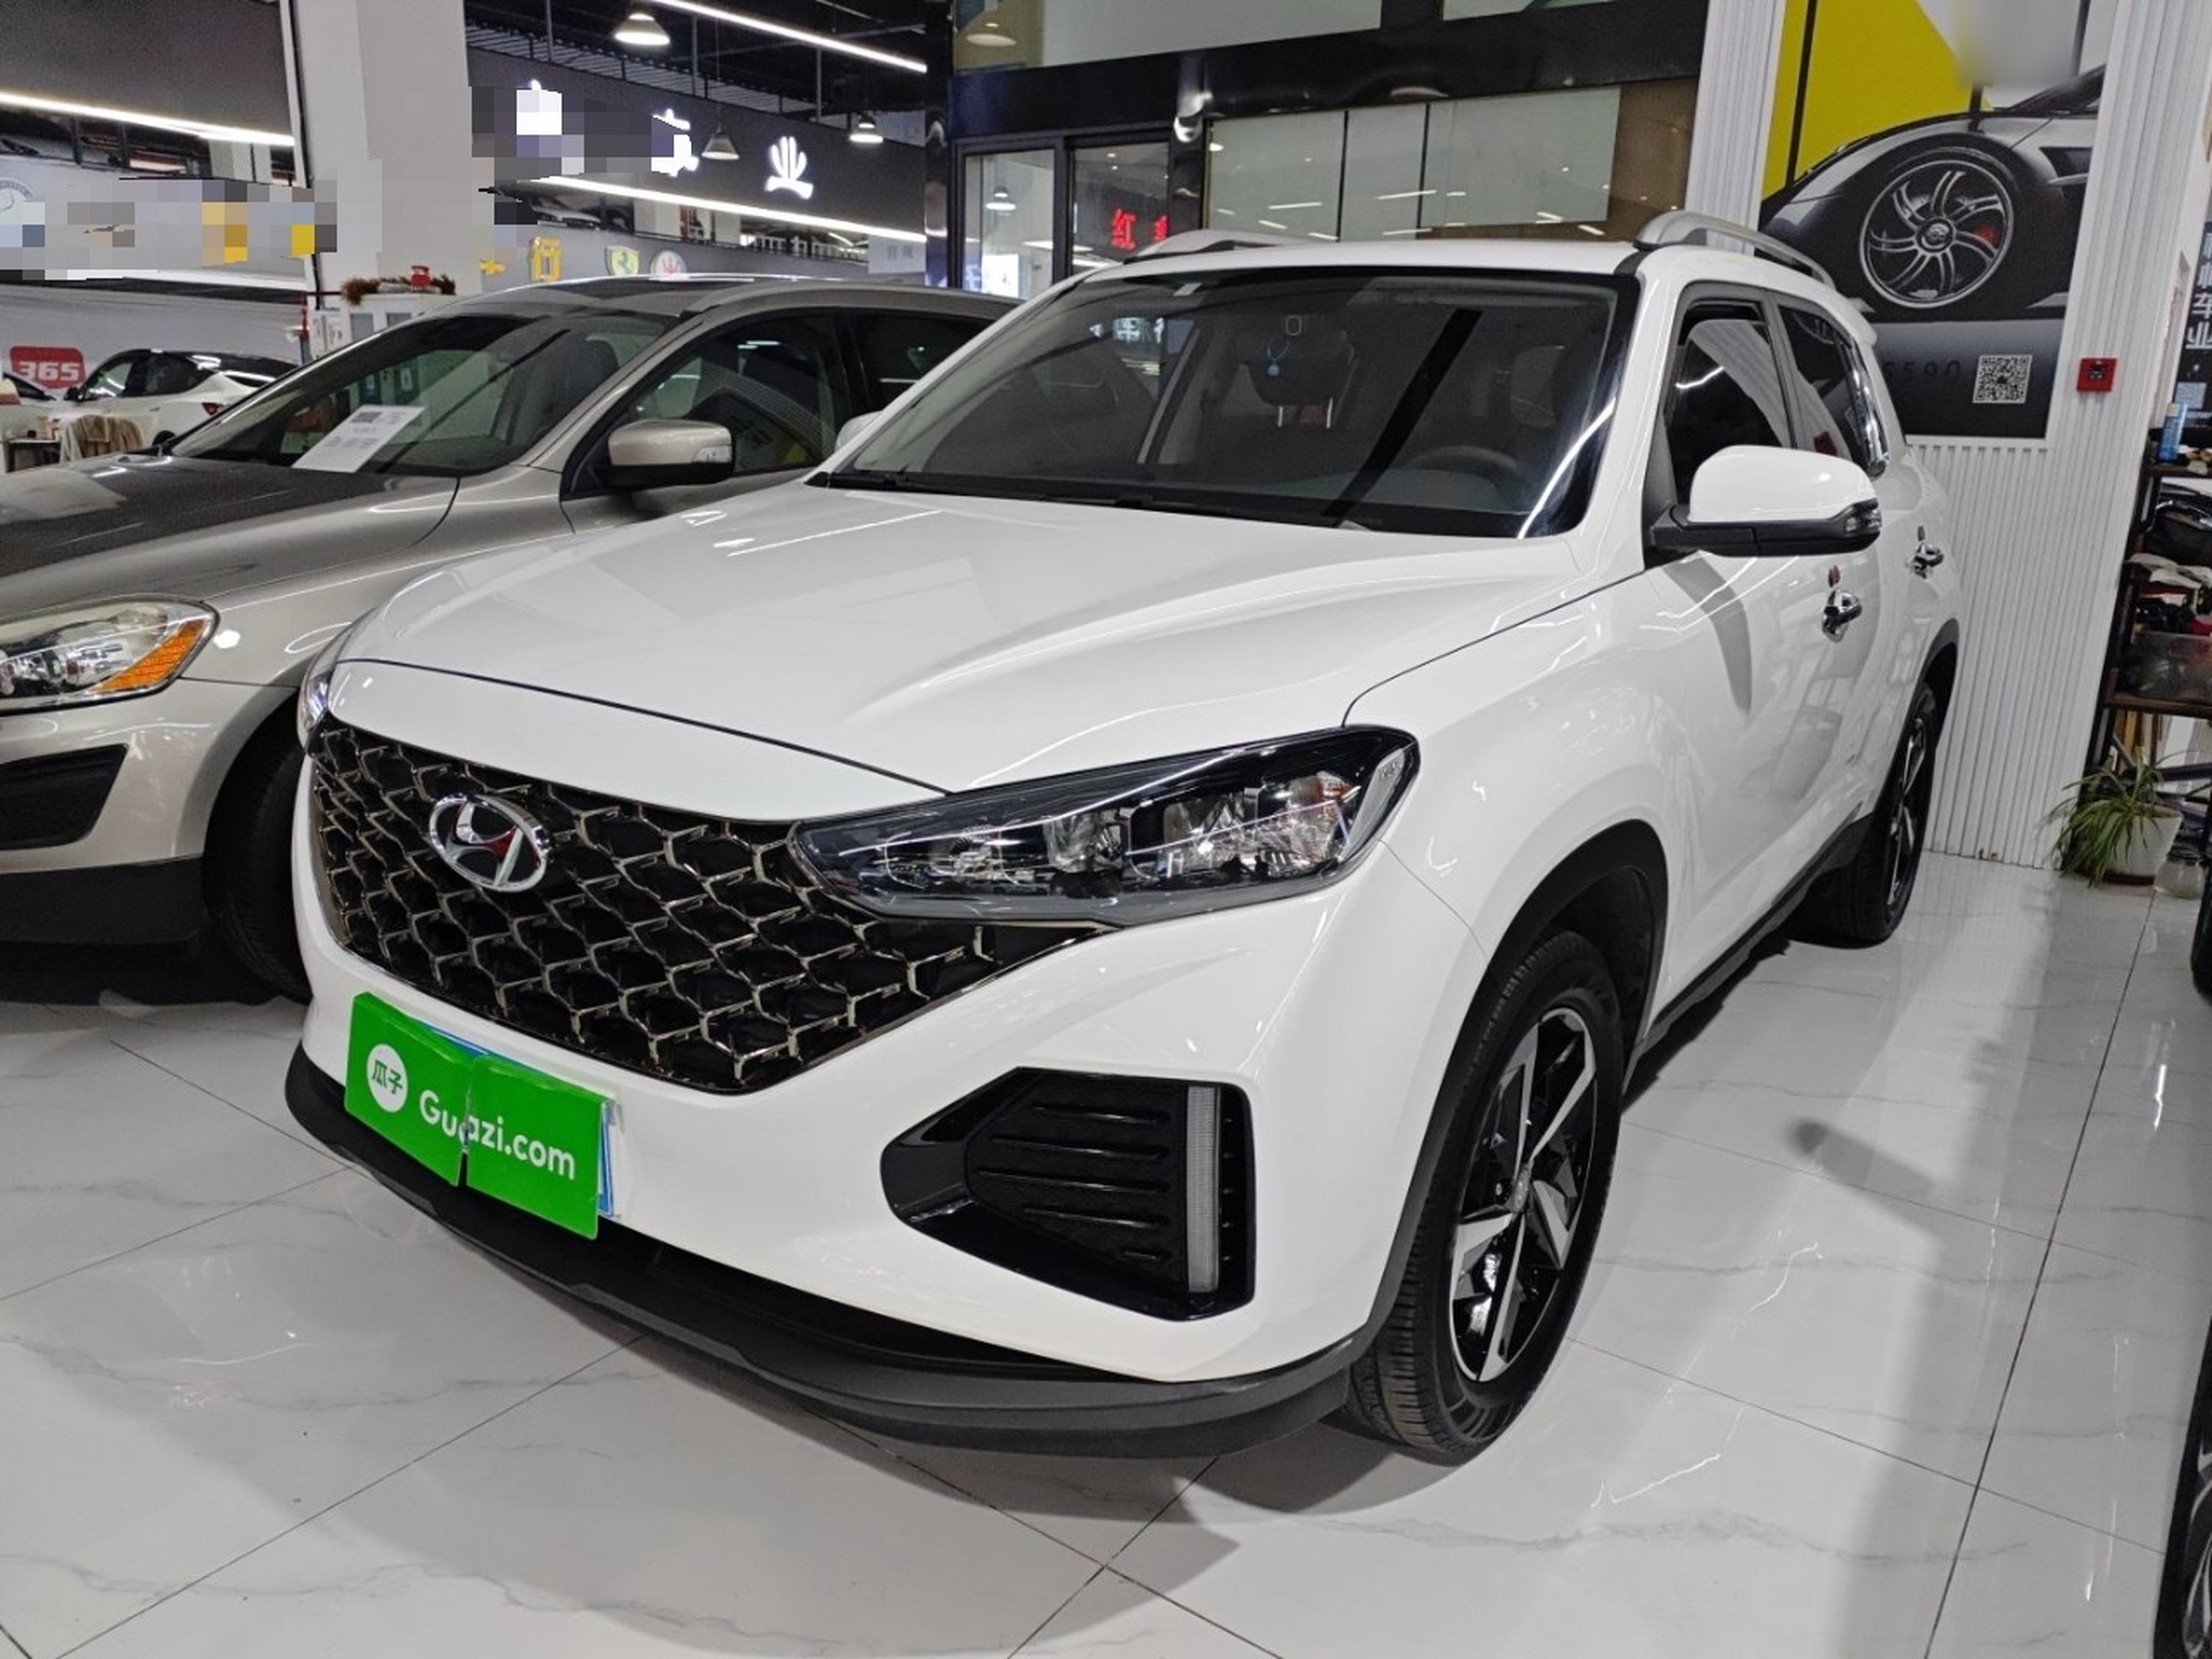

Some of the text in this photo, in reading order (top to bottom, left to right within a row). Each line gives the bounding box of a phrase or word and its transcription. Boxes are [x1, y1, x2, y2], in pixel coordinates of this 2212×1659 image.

[18, 361, 81, 381] 365
[372, 1059, 403, 1096] 瓜子
[419, 1089, 575, 1181] Guazi.com
